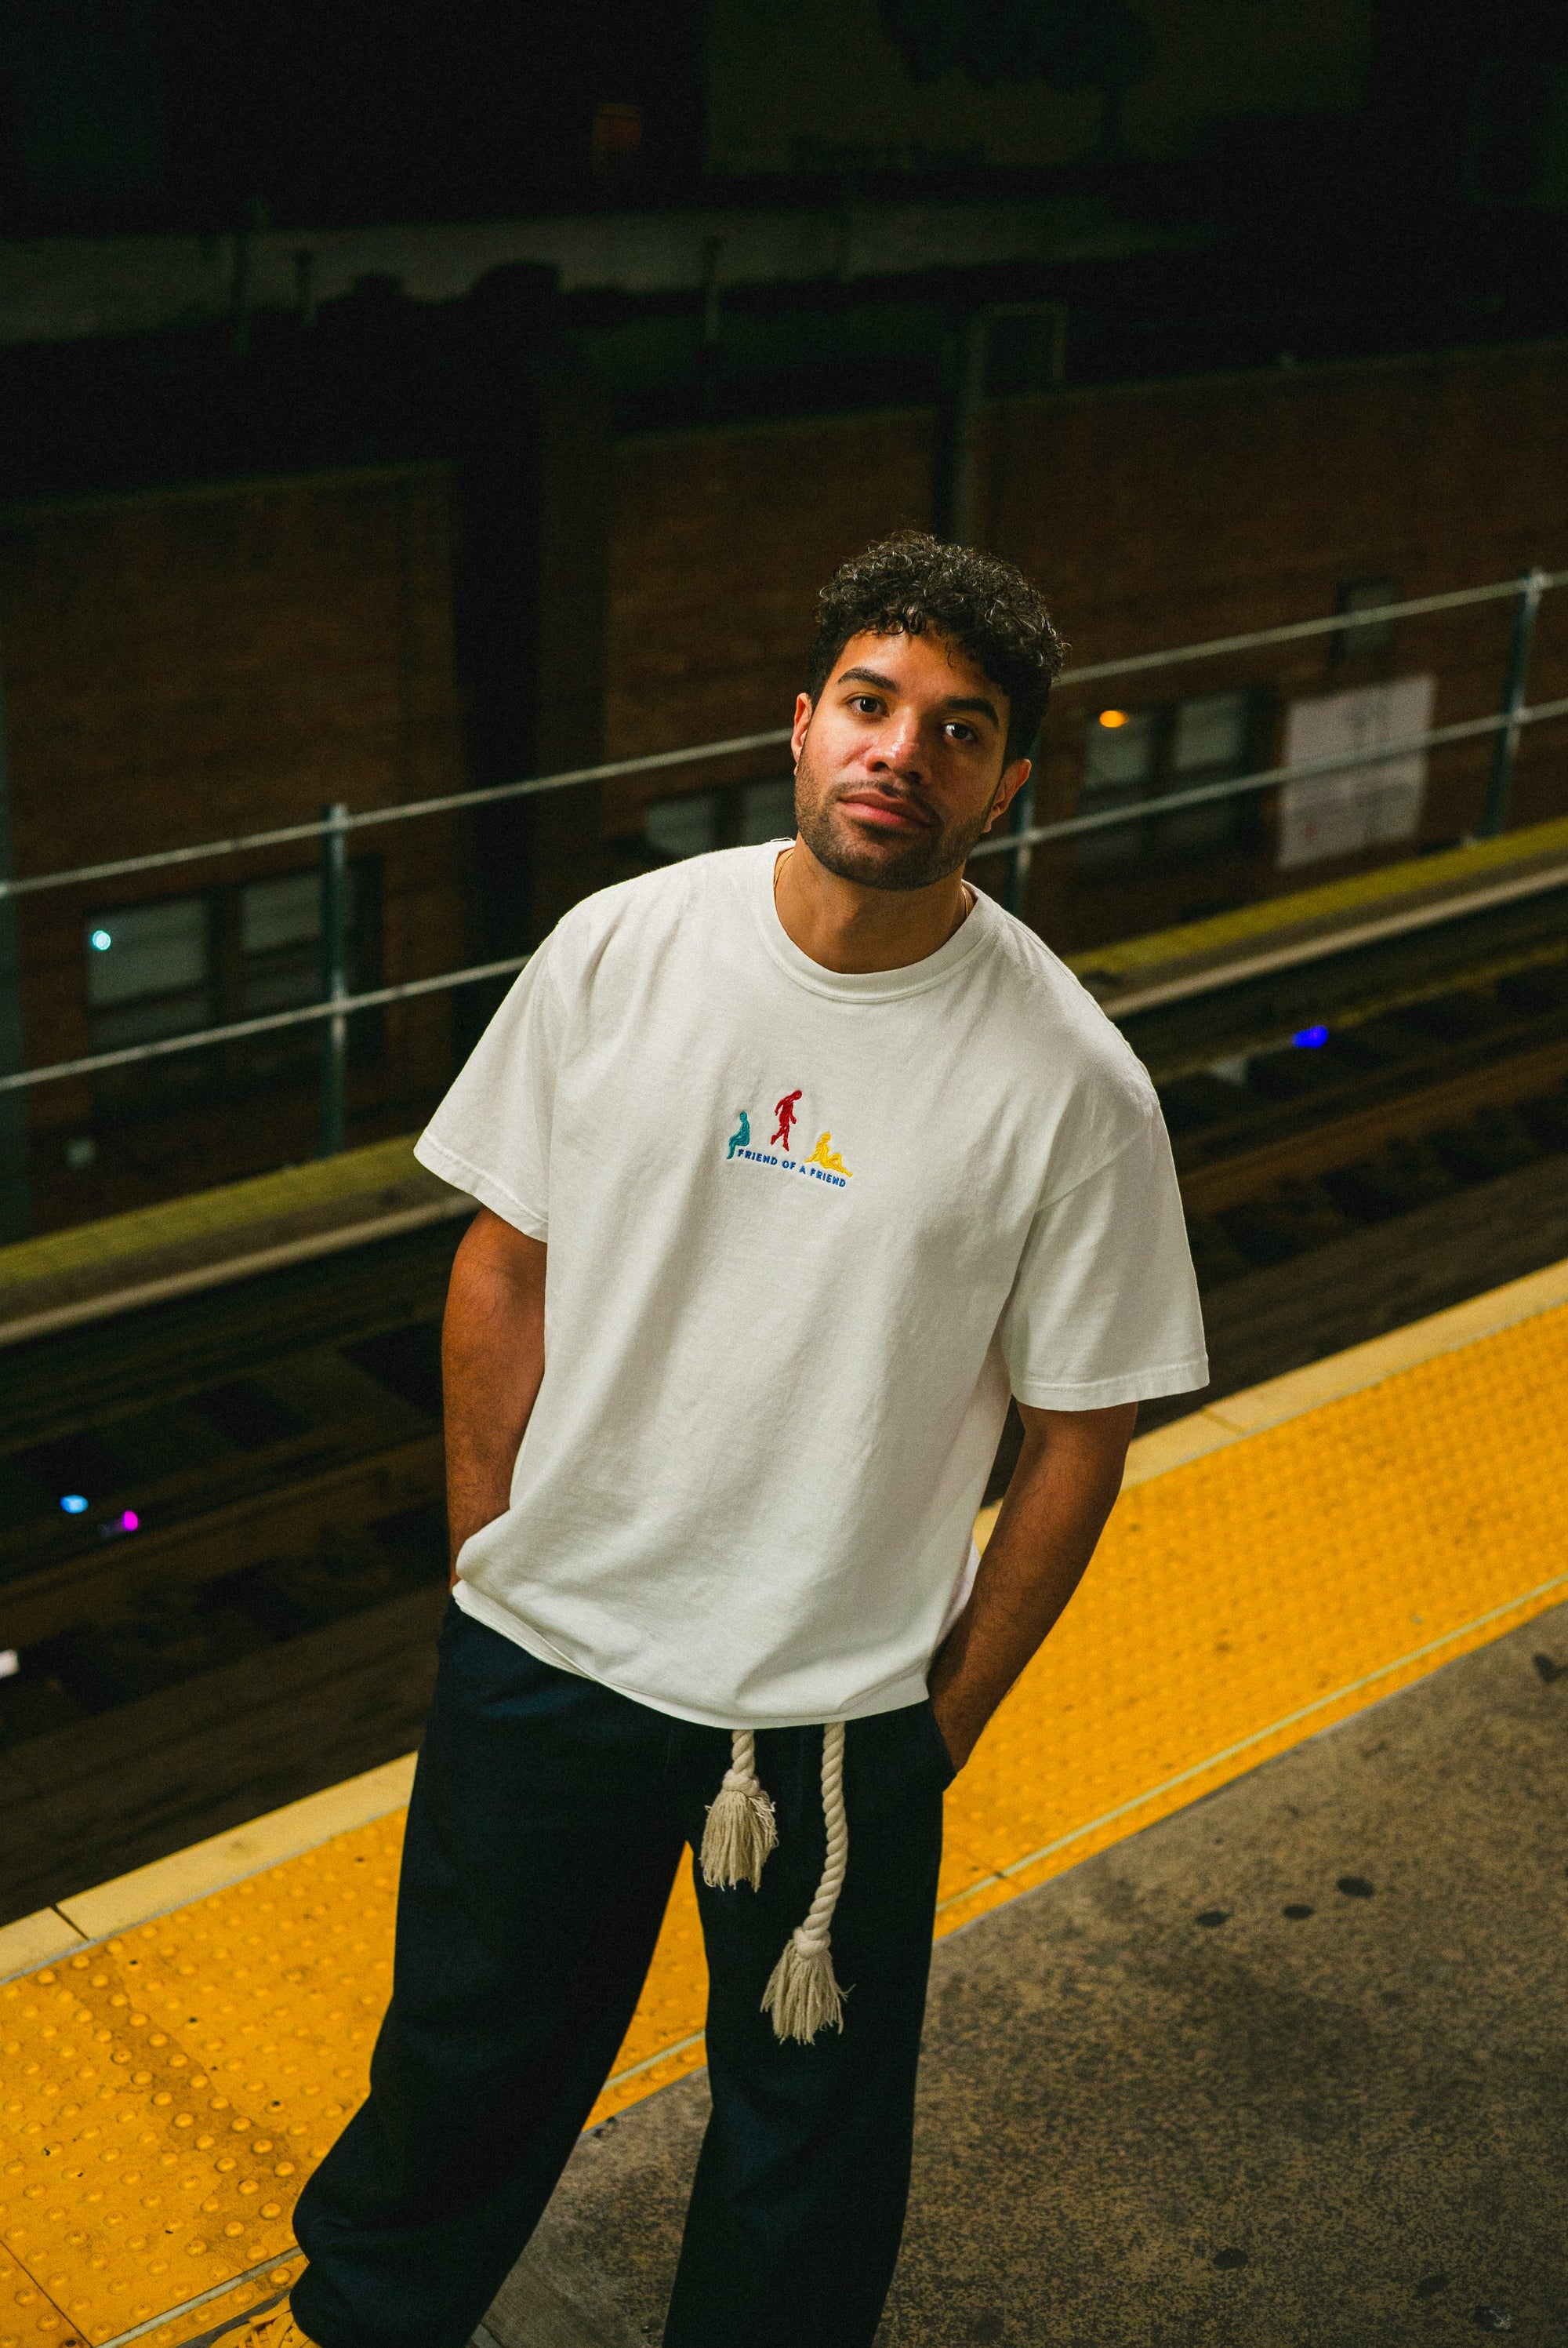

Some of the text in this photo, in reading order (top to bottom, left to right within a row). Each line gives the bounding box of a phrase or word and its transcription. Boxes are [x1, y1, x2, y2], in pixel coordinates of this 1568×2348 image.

[738, 1149, 846, 1187] FRIEND OF A FRIEND
